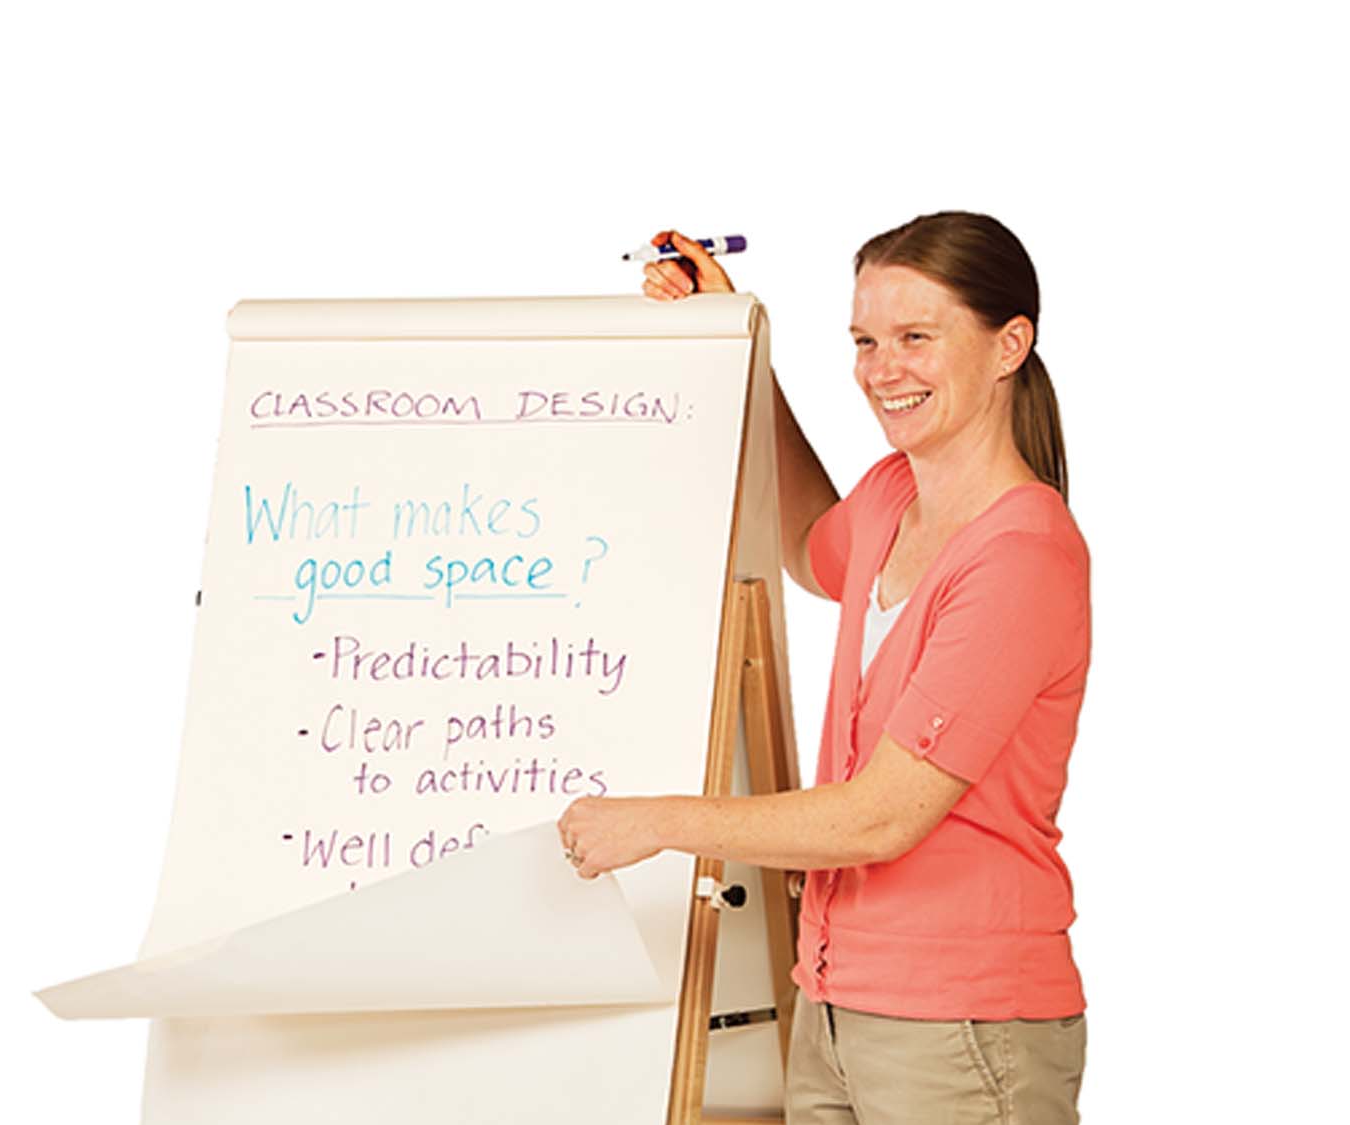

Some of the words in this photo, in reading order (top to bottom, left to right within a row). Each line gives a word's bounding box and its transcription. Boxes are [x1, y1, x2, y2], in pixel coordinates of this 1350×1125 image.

[250, 390, 482, 422] CLASSROOM
[515, 391, 696, 424] DESIGN:
[244, 482, 372, 544] What
[392, 484, 542, 540] makes
[292, 550, 393, 624] good
[424, 553, 553, 609] space
[445, 705, 557, 760] paths
[353, 763, 392, 795] to
[416, 757, 610, 799] activities
